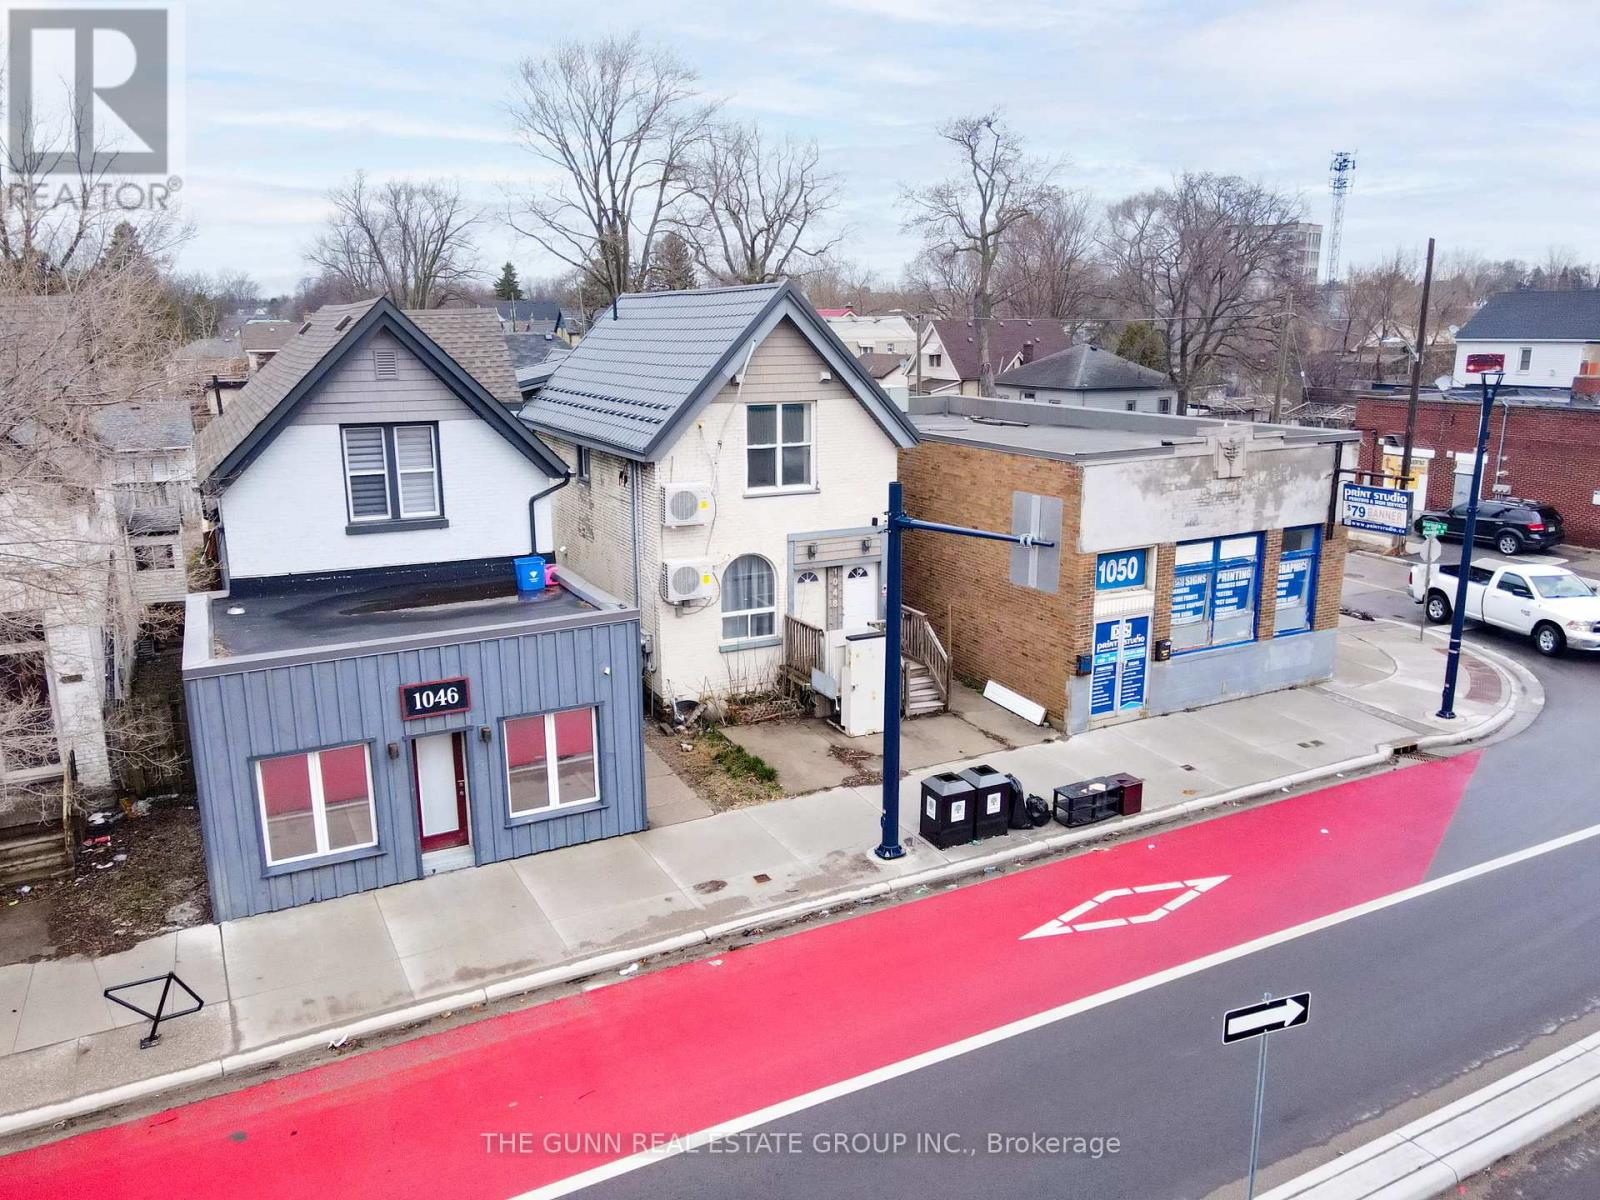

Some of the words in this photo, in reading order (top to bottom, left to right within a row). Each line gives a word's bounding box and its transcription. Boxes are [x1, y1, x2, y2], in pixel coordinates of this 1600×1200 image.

[1368, 507, 1402, 522] BANNER
[1099, 556, 1138, 584] 1050
[1216, 568, 1251, 583] PRINTING
[1185, 573, 1207, 586] SIGNS
[413, 687, 459, 710] 1046
